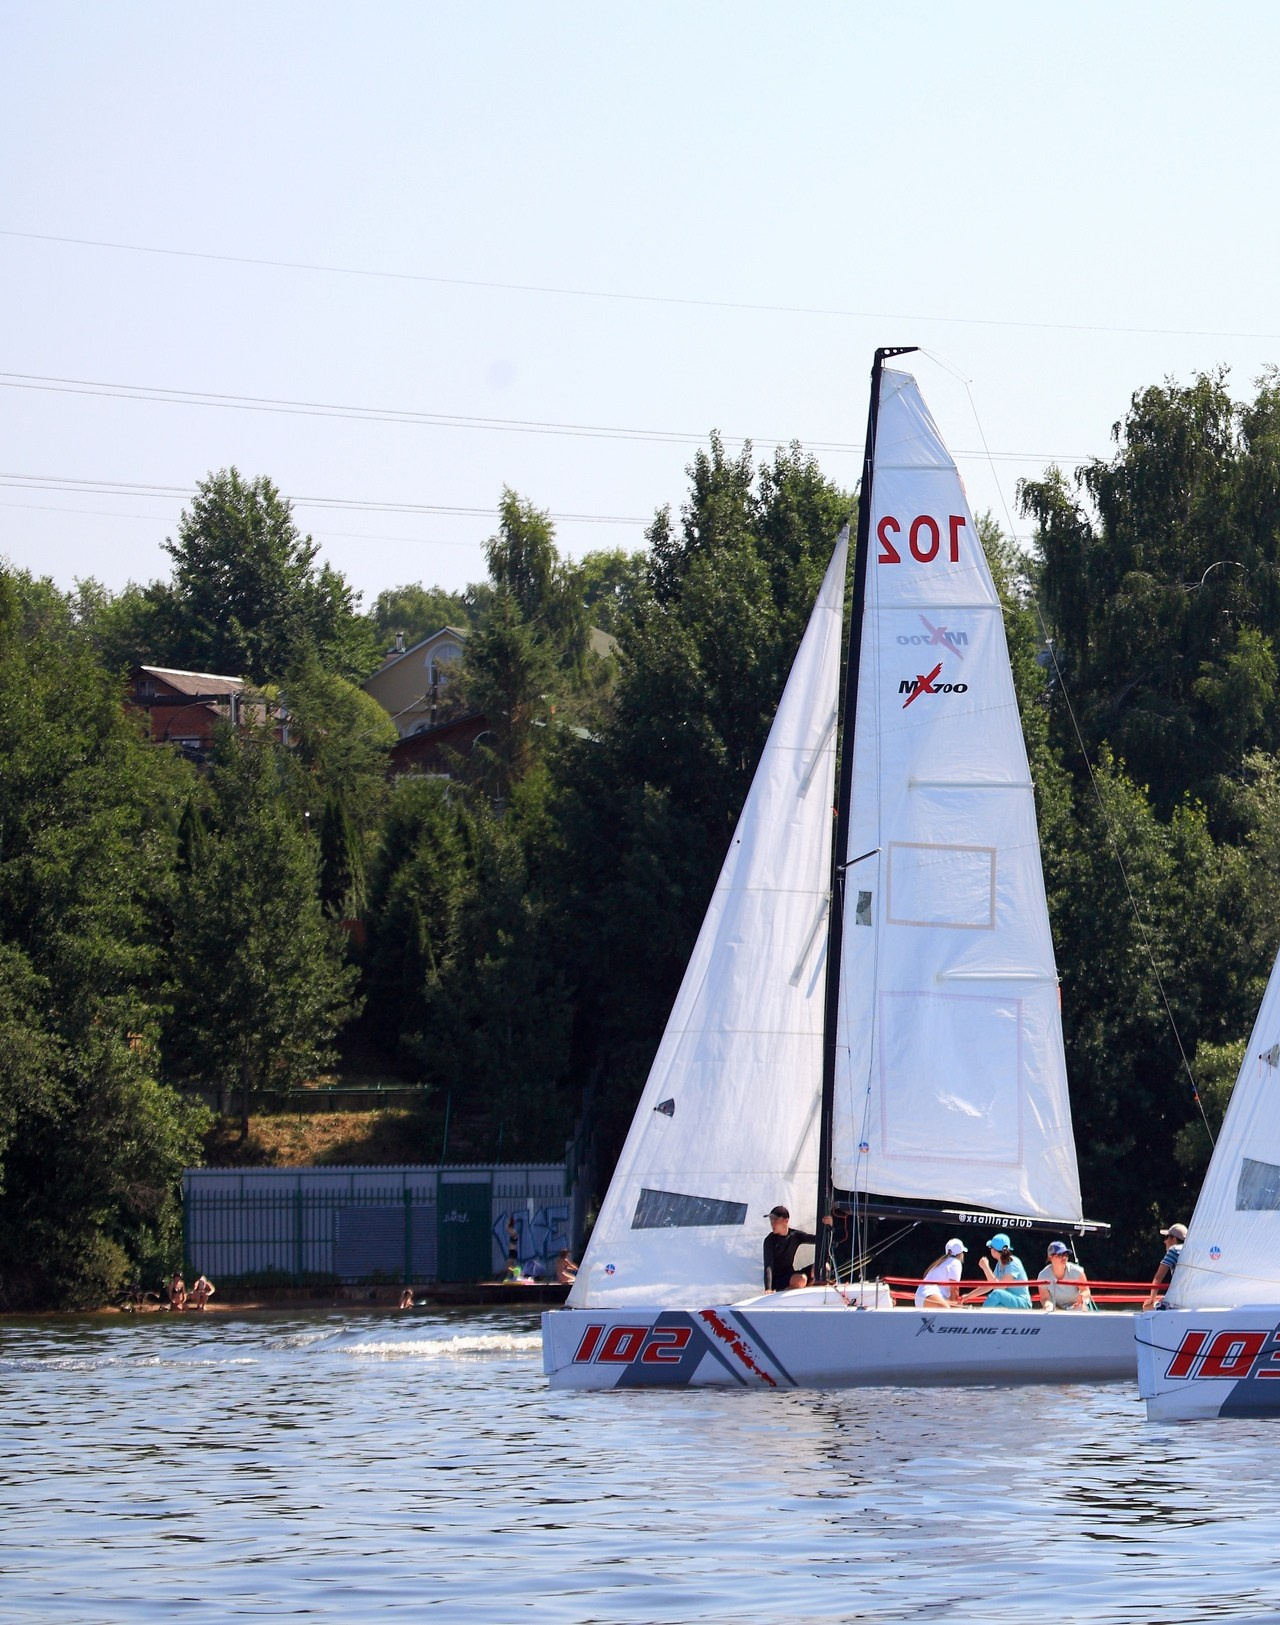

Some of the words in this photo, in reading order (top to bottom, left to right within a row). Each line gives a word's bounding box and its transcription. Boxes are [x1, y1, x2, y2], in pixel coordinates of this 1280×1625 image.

[898, 661, 969, 710] MX700
[958, 1213, 1033, 1228] @xsailingclub
[572, 1323, 693, 1365] 102
[937, 1326, 998, 1335] SAILING
[1001, 1327, 1041, 1336] CLUB
